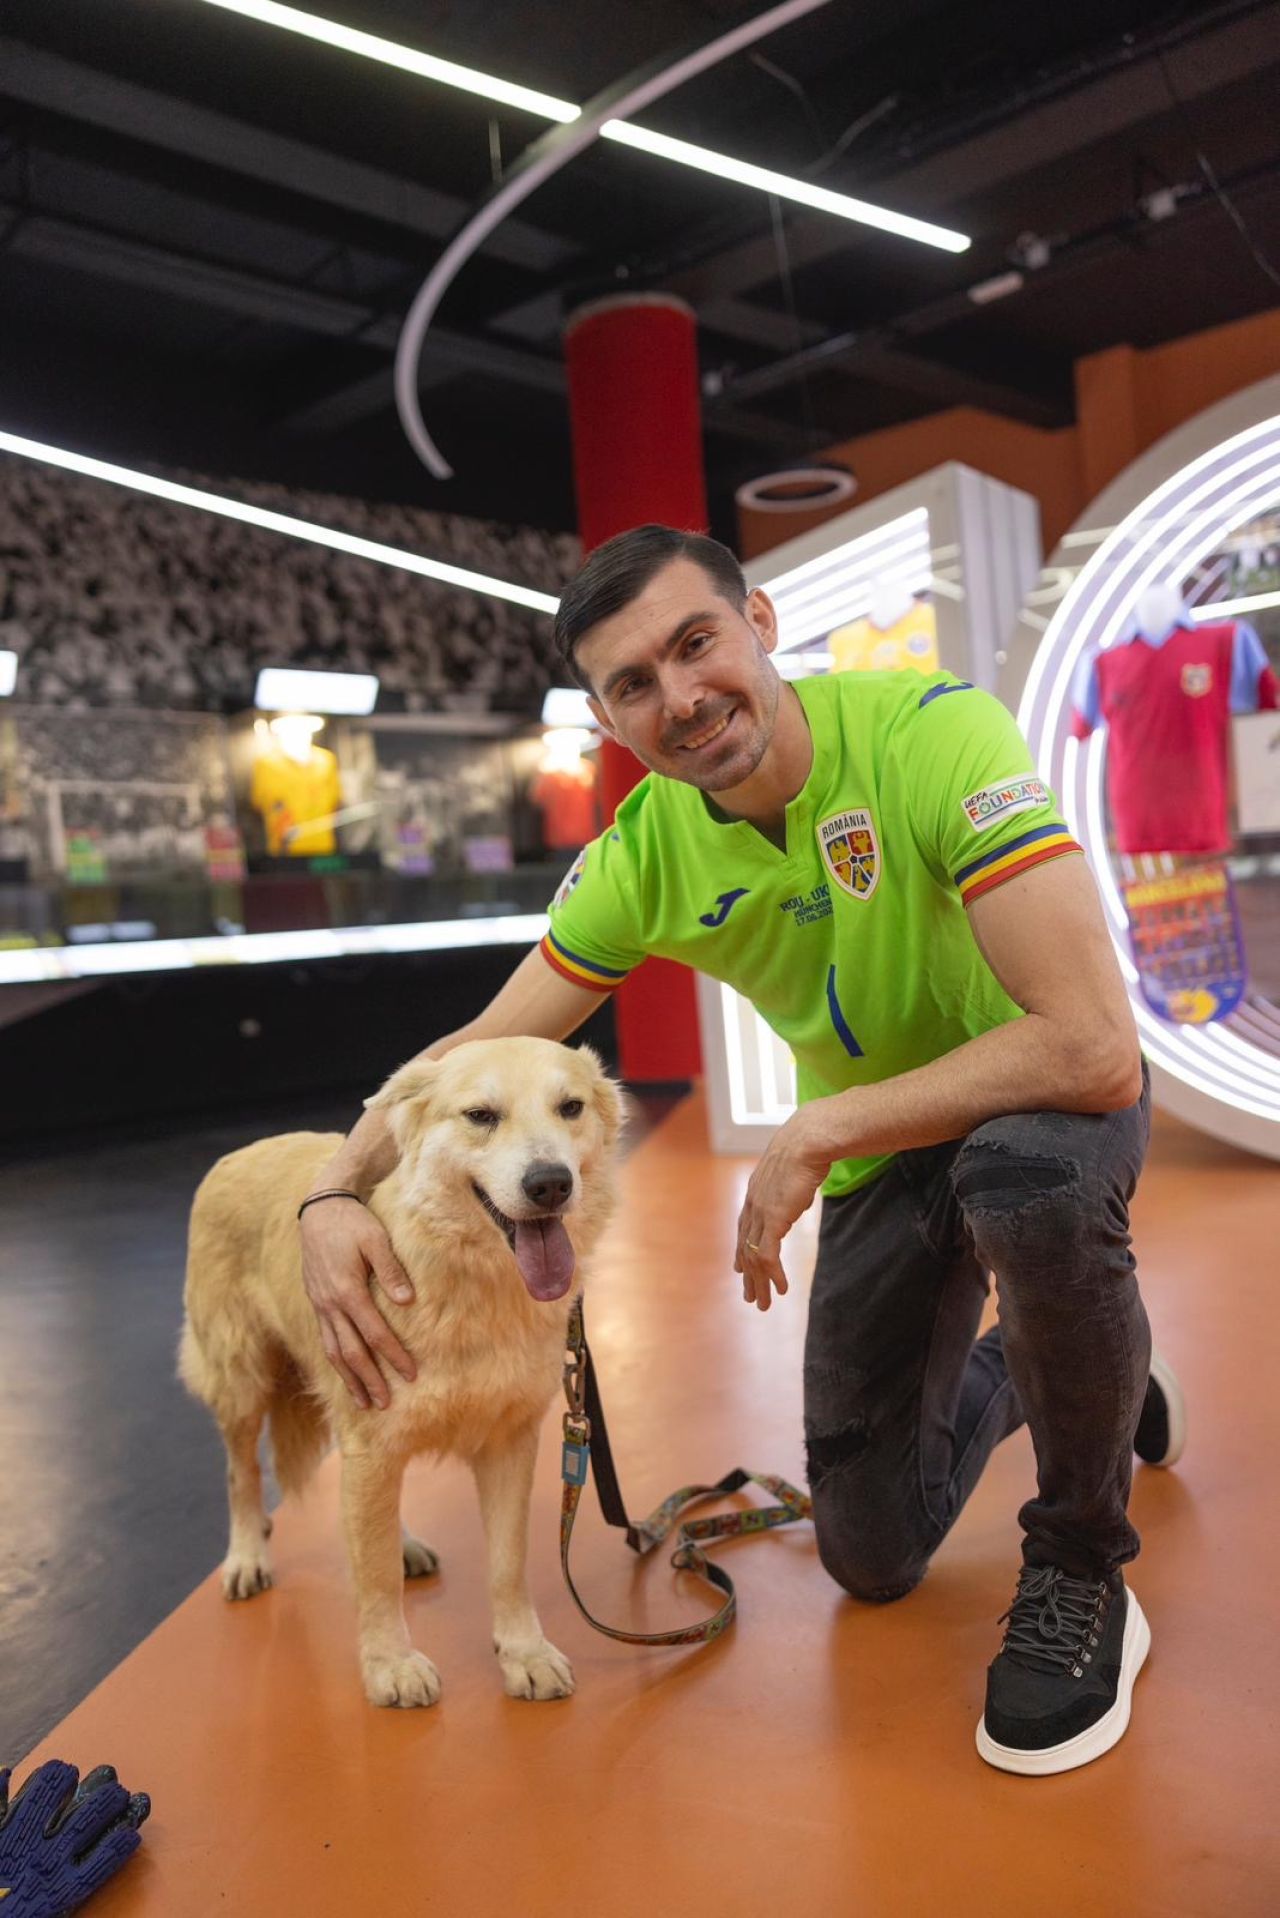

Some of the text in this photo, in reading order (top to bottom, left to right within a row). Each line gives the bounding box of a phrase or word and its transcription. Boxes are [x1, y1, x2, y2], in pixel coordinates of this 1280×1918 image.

[964, 791, 988, 809] UEFA
[781, 896, 804, 911] ROU
[811, 884, 830, 900] UK
